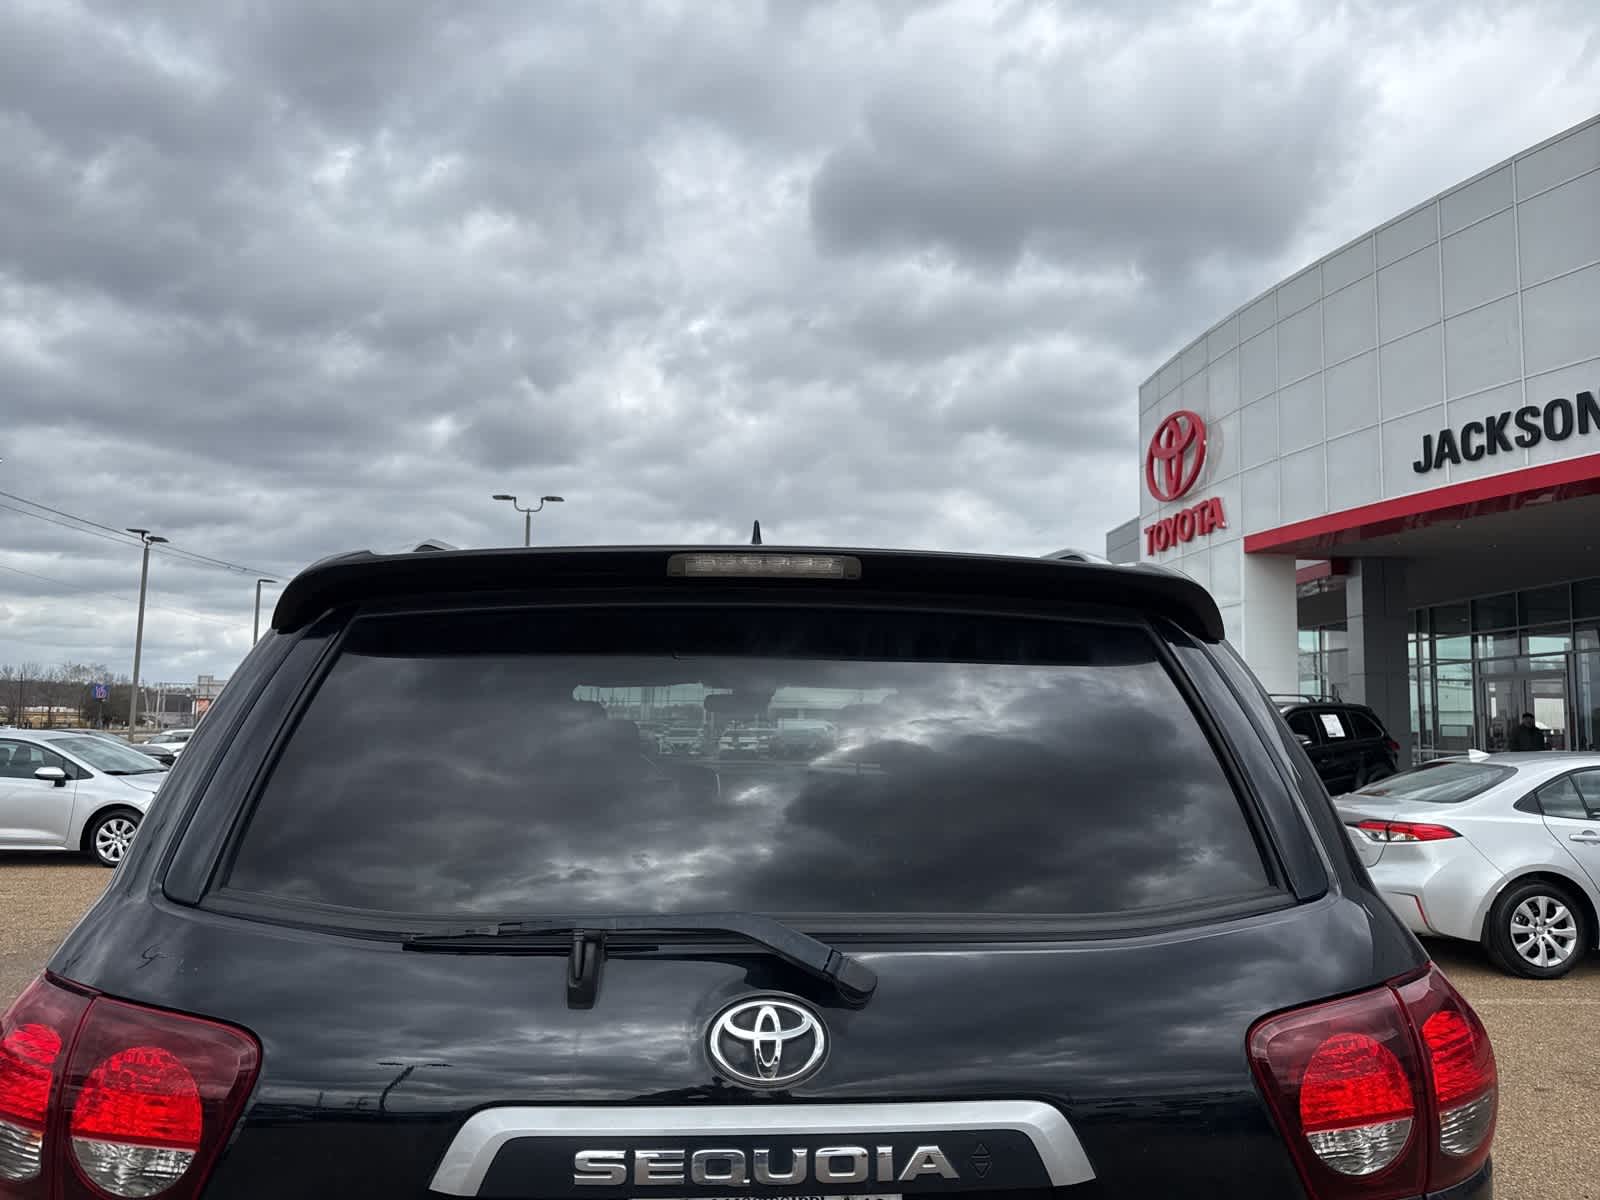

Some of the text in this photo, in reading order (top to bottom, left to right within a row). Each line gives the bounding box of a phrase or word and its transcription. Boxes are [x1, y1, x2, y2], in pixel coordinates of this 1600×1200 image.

[1412, 391, 1600, 474] JACKSON
[1143, 497, 1227, 556] TOYOTA
[573, 1145, 960, 1186] SEQUOIA
